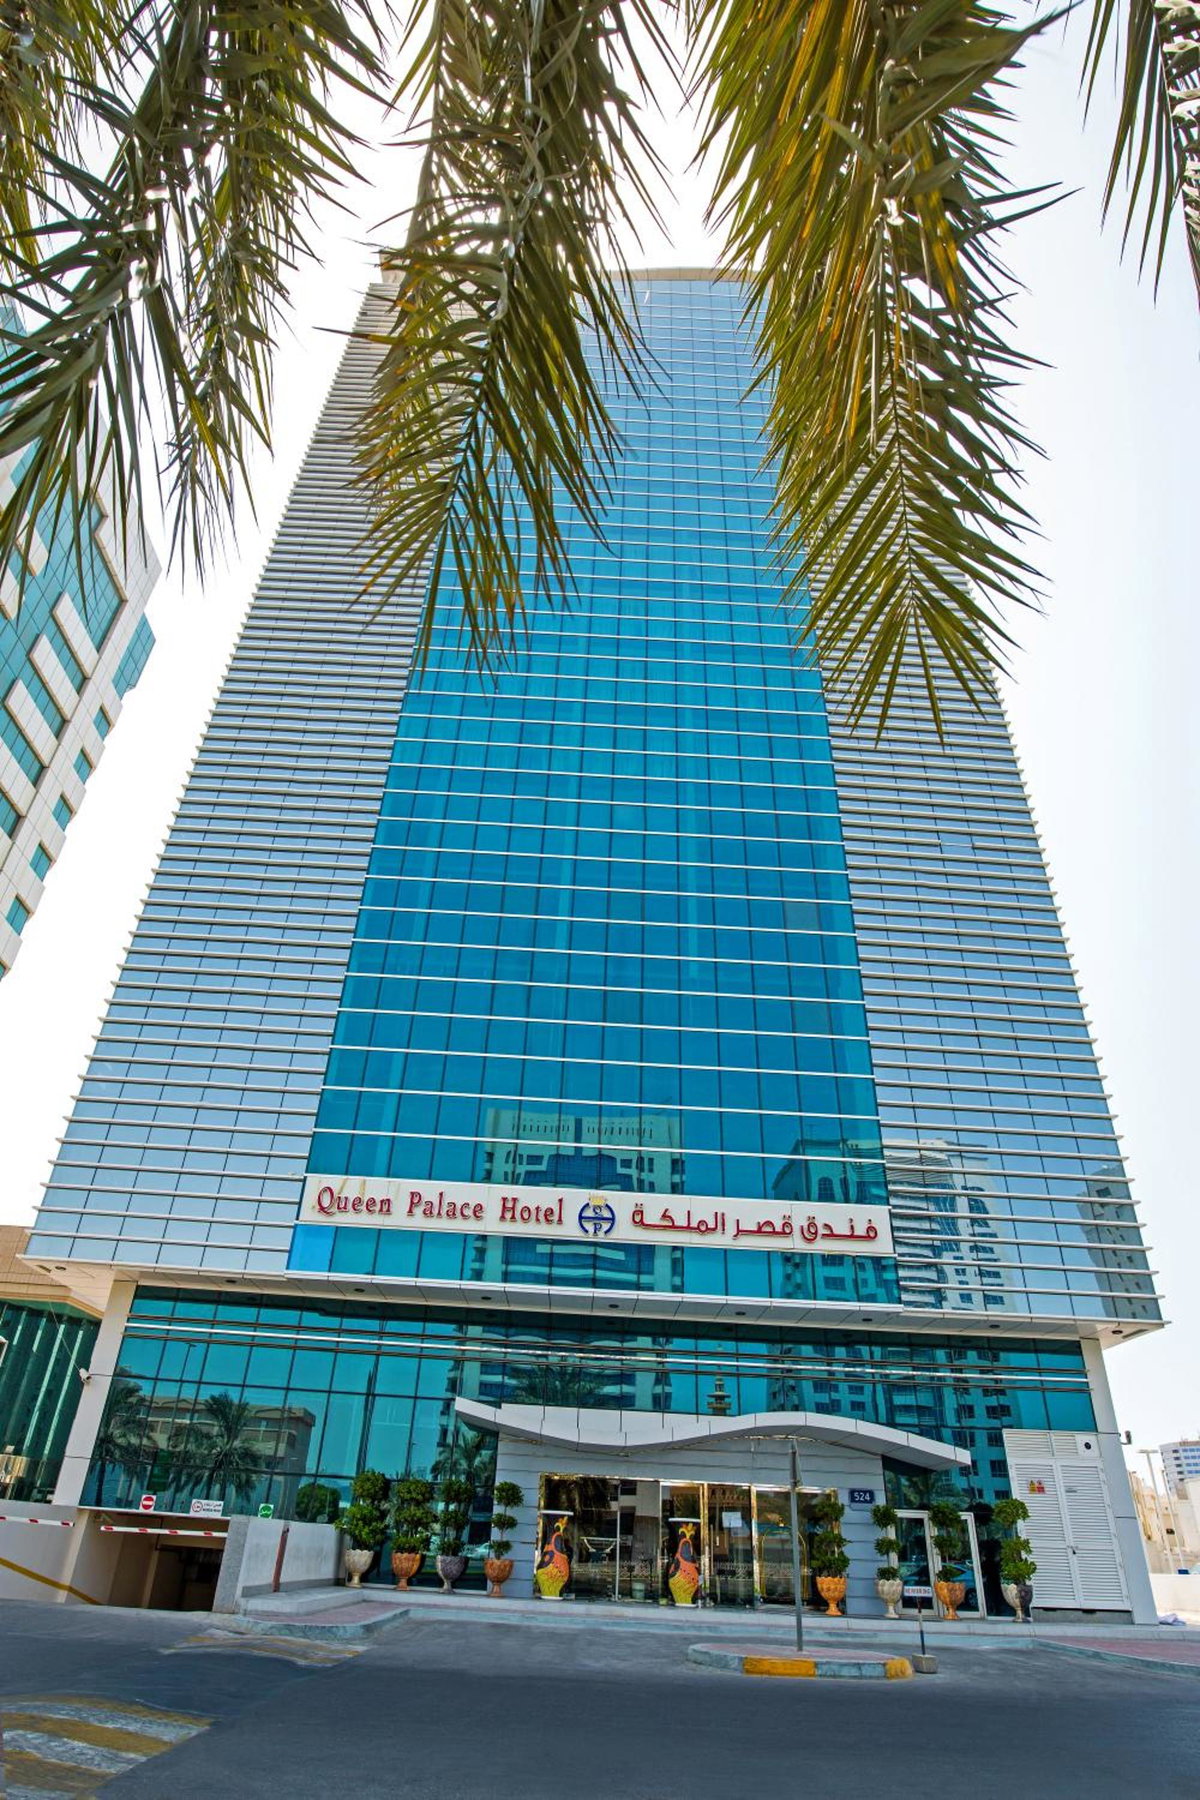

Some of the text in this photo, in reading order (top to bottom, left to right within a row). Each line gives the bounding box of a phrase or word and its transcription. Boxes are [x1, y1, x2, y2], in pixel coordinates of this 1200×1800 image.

[317, 1186, 564, 1225] Queen Palace Hotel
[631, 1203, 878, 1243] فندق قصر الملكة
[853, 1491, 871, 1501] 524
